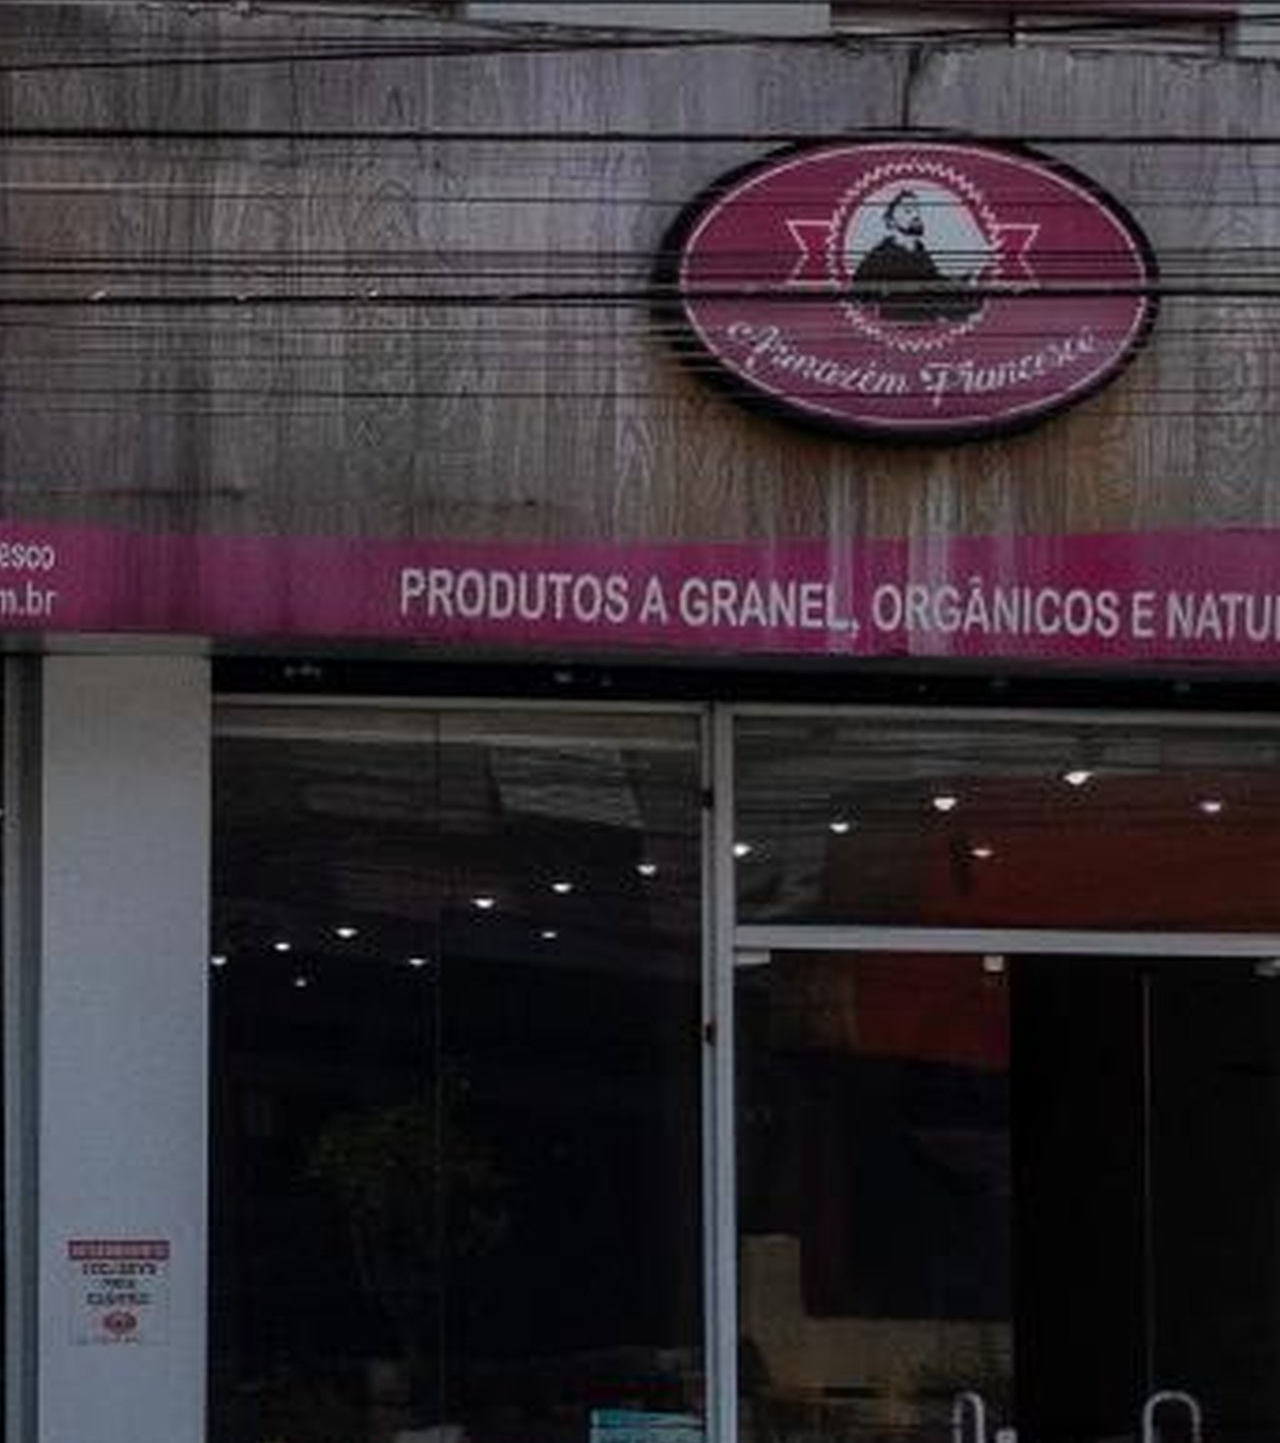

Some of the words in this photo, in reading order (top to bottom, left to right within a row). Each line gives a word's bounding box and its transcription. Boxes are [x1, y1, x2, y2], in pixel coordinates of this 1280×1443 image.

[399, 568, 629, 624] PRODUTOS
[640, 575, 667, 624] A
[678, 576, 861, 640] GRANEL,
[873, 576, 1121, 639] ORGÂNICOS
[1132, 590, 1156, 639] E
